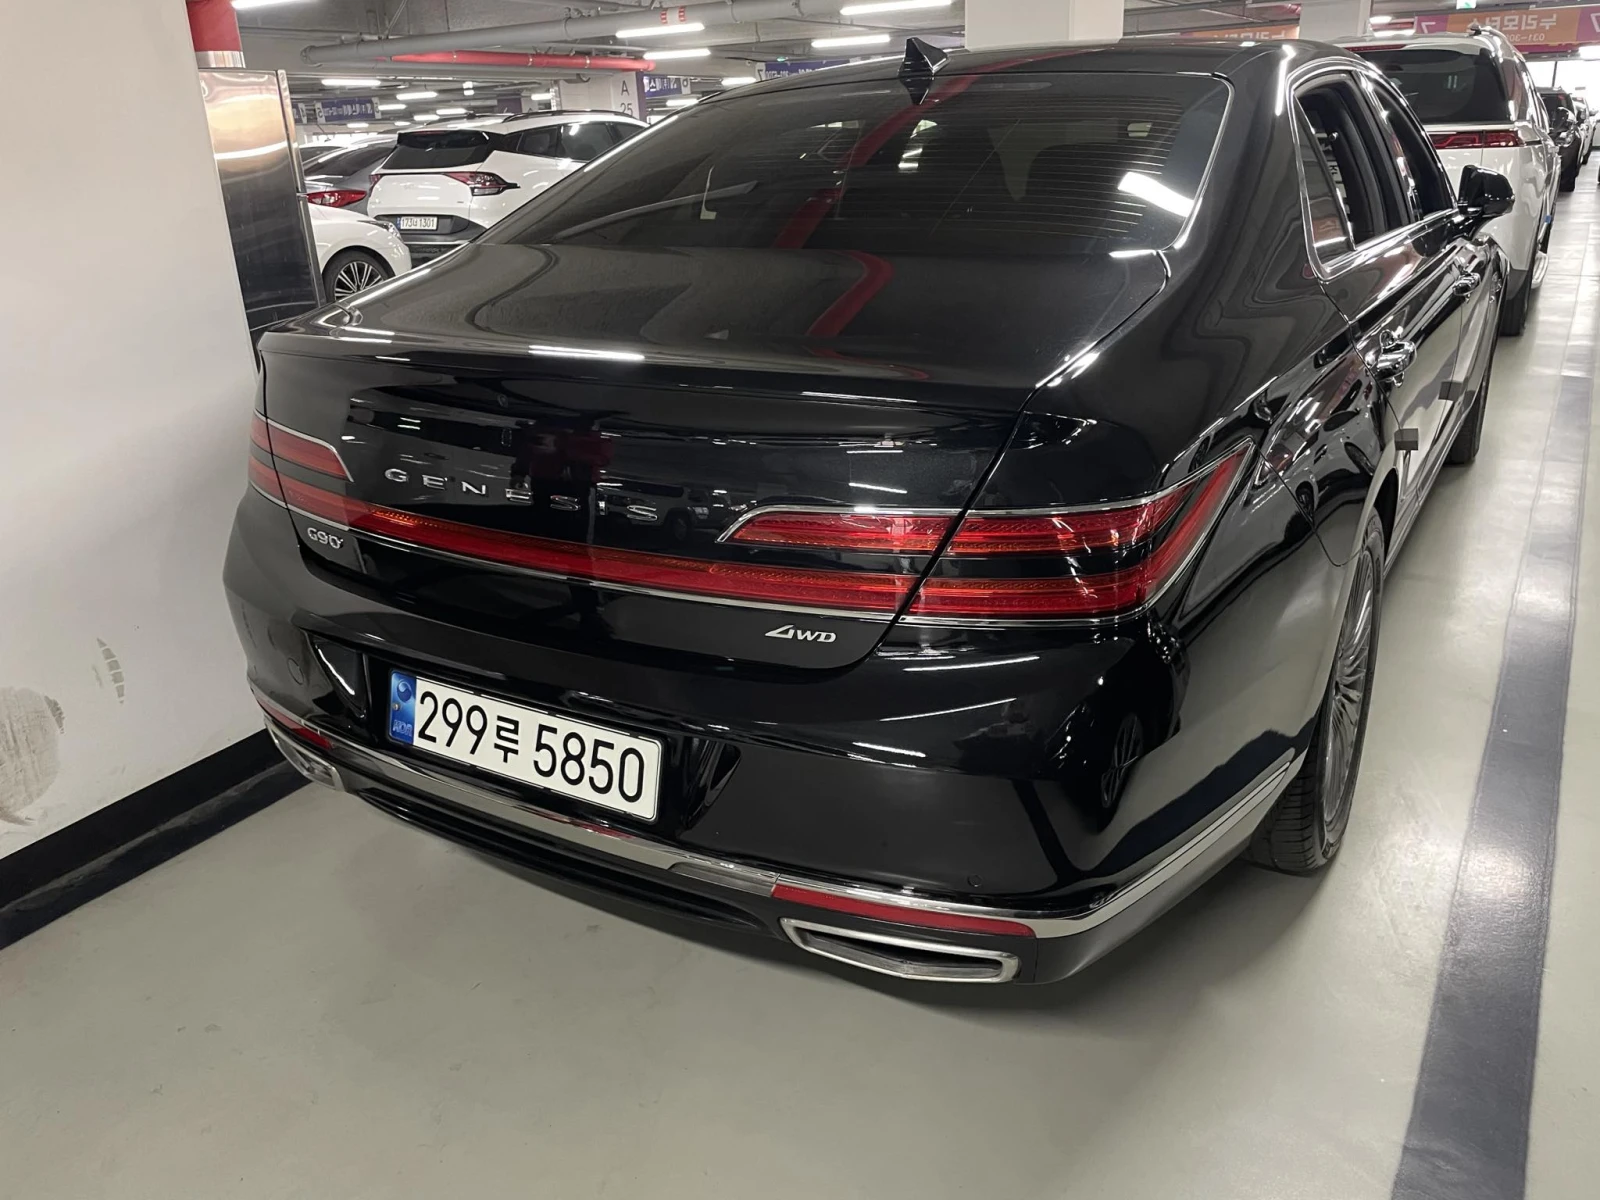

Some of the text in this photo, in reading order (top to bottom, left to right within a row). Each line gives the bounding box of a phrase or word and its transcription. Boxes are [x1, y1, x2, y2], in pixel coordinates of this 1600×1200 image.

[621, 80, 630, 96] A
[419, 217, 435, 227] 1301
[384, 468, 658, 522] GENESIS
[307, 527, 343, 549] G90
[764, 624, 837, 643] 4WD
[417, 690, 645, 803] 299루 5850
